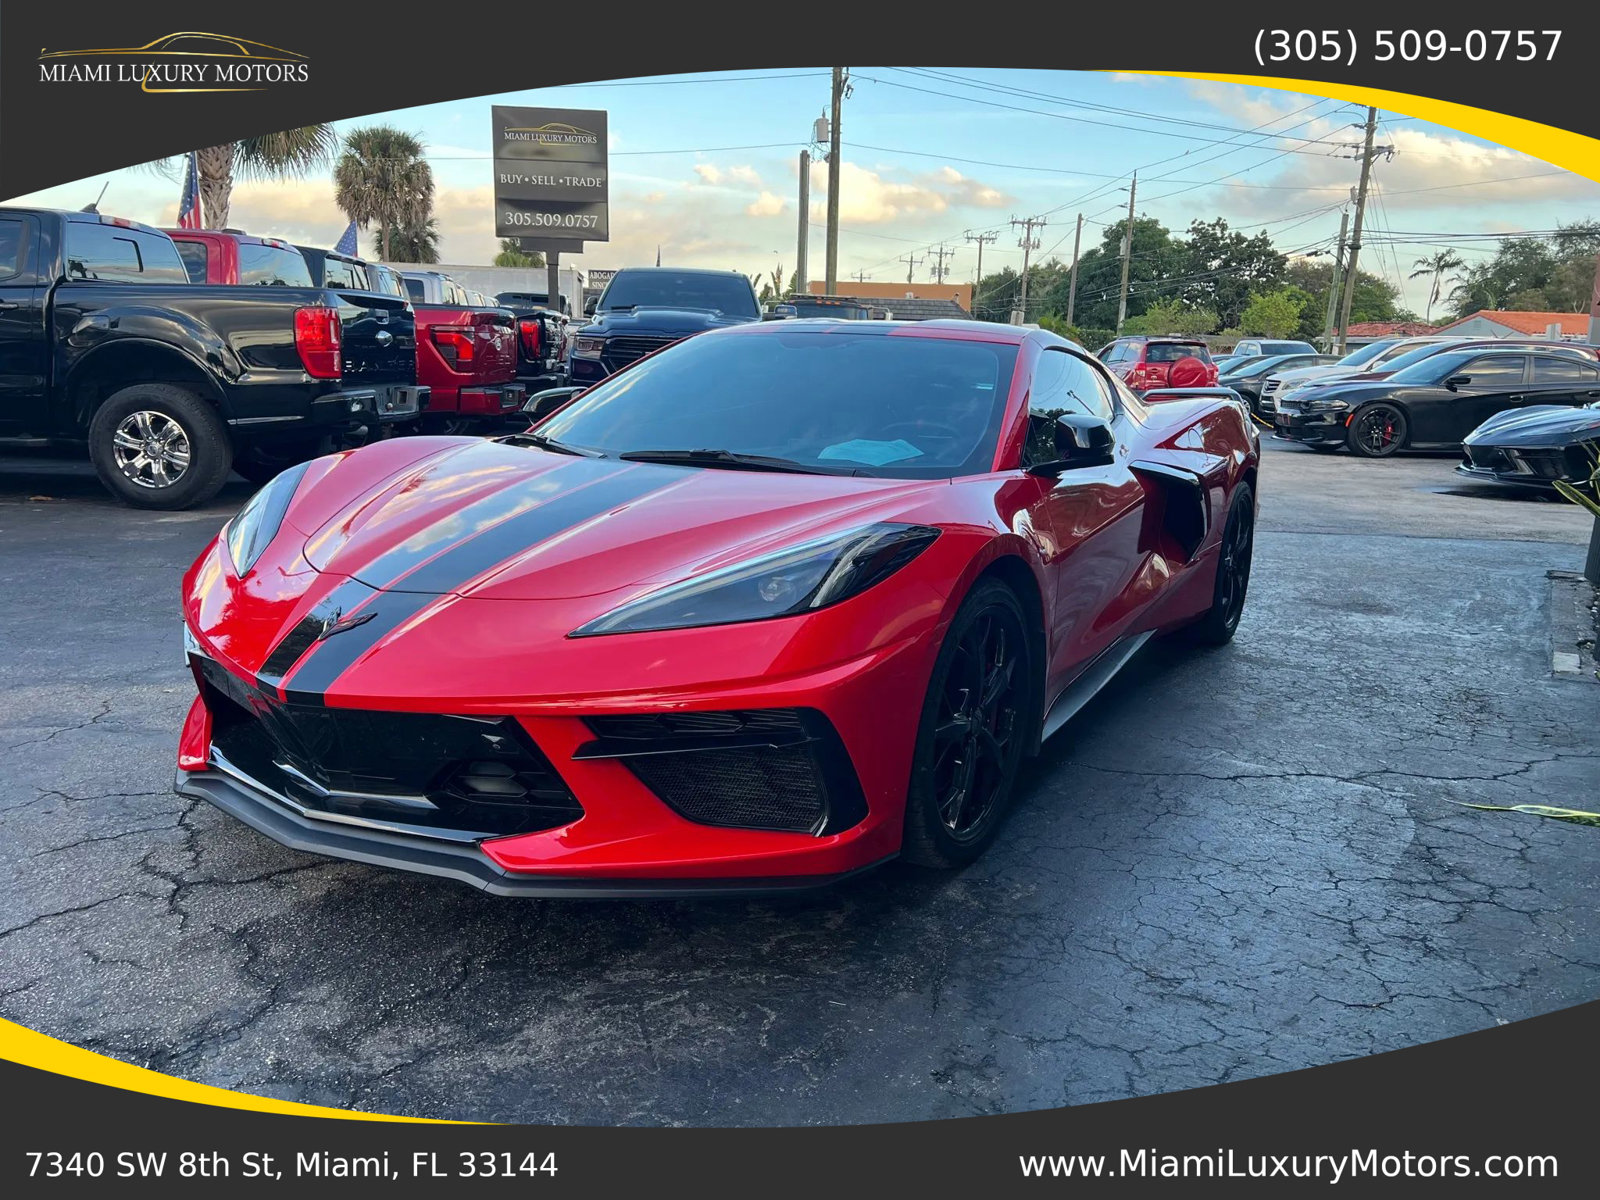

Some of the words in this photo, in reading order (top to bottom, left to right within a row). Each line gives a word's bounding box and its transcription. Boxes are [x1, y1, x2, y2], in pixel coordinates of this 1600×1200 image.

[504, 132, 530, 141] MIAMI
[531, 133, 563, 142] LUXURY
[564, 135, 597, 144] MOTORS
[500, 173, 523, 184] BUY
[531, 174, 556, 186] SELL
[564, 176, 602, 188] TRADE
[505, 211, 598, 228] 305.509.0757
